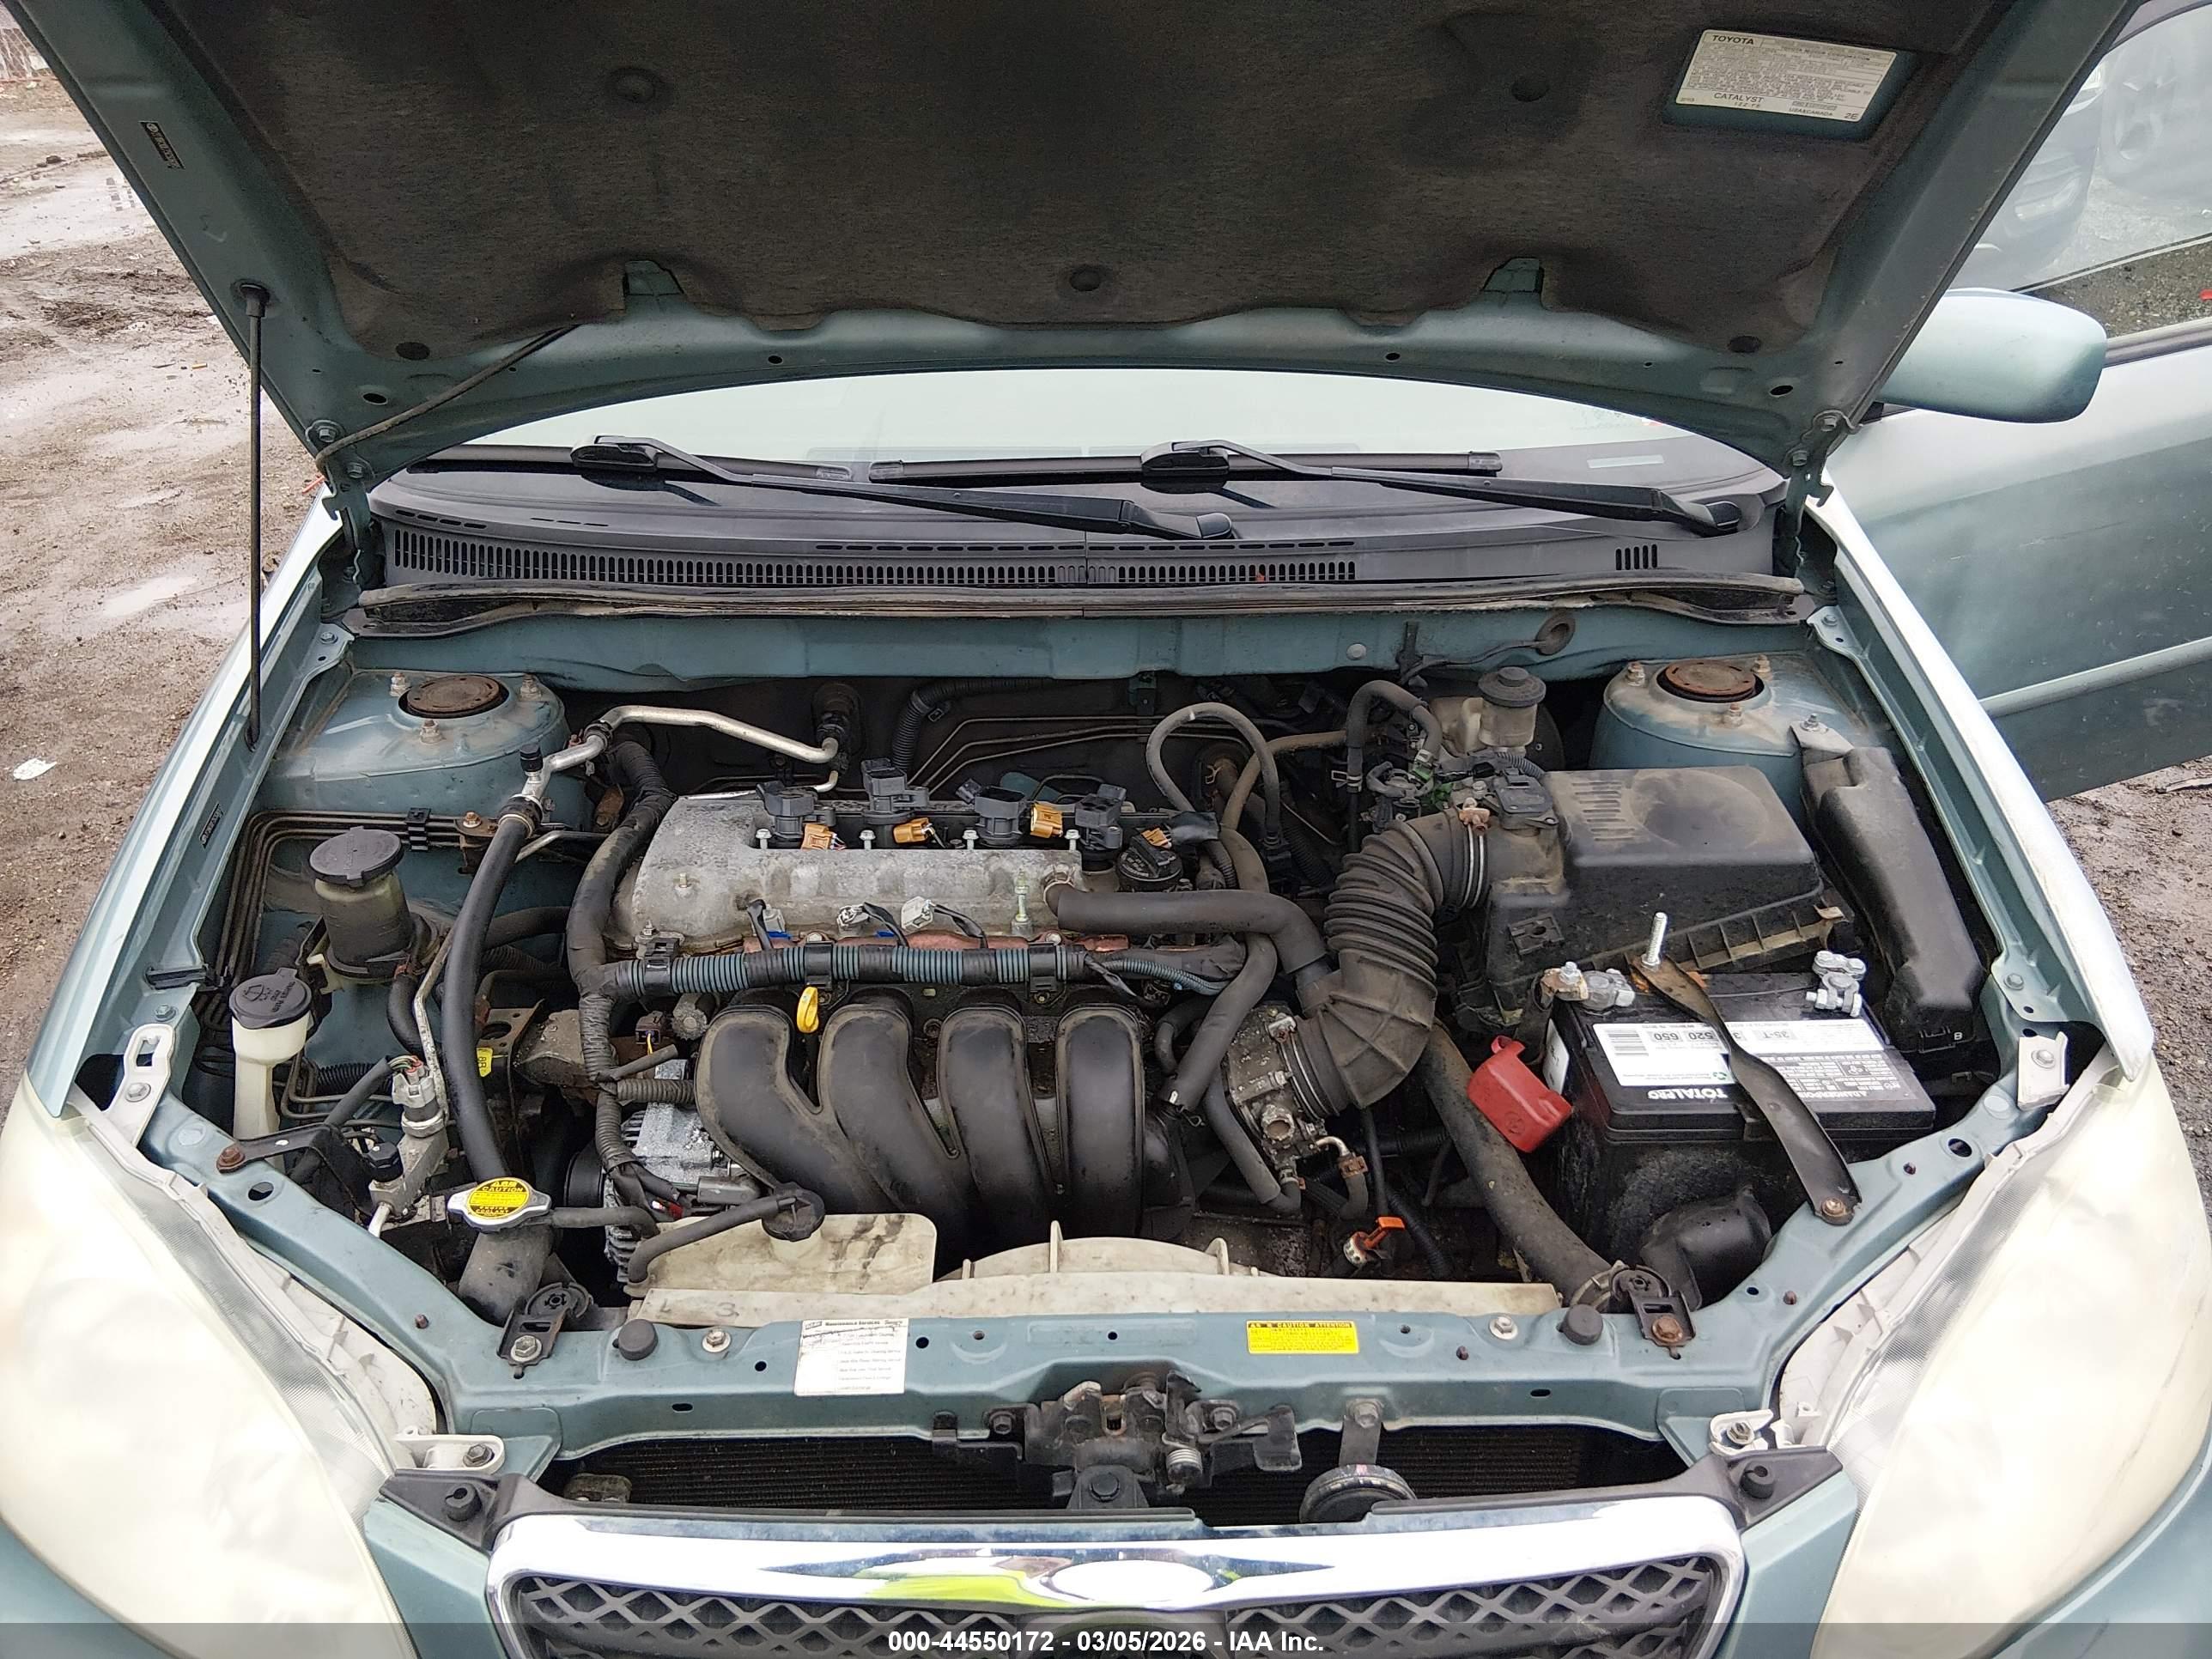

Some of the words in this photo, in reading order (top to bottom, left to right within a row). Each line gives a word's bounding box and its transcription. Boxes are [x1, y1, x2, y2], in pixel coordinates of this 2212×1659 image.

[1711, 34, 1754, 45] TOYOTA
[1714, 92, 1764, 103] CATALYST
[1653, 1032, 1680, 1041] 650
[1647, 1088, 1728, 1100] TOTALPRO
